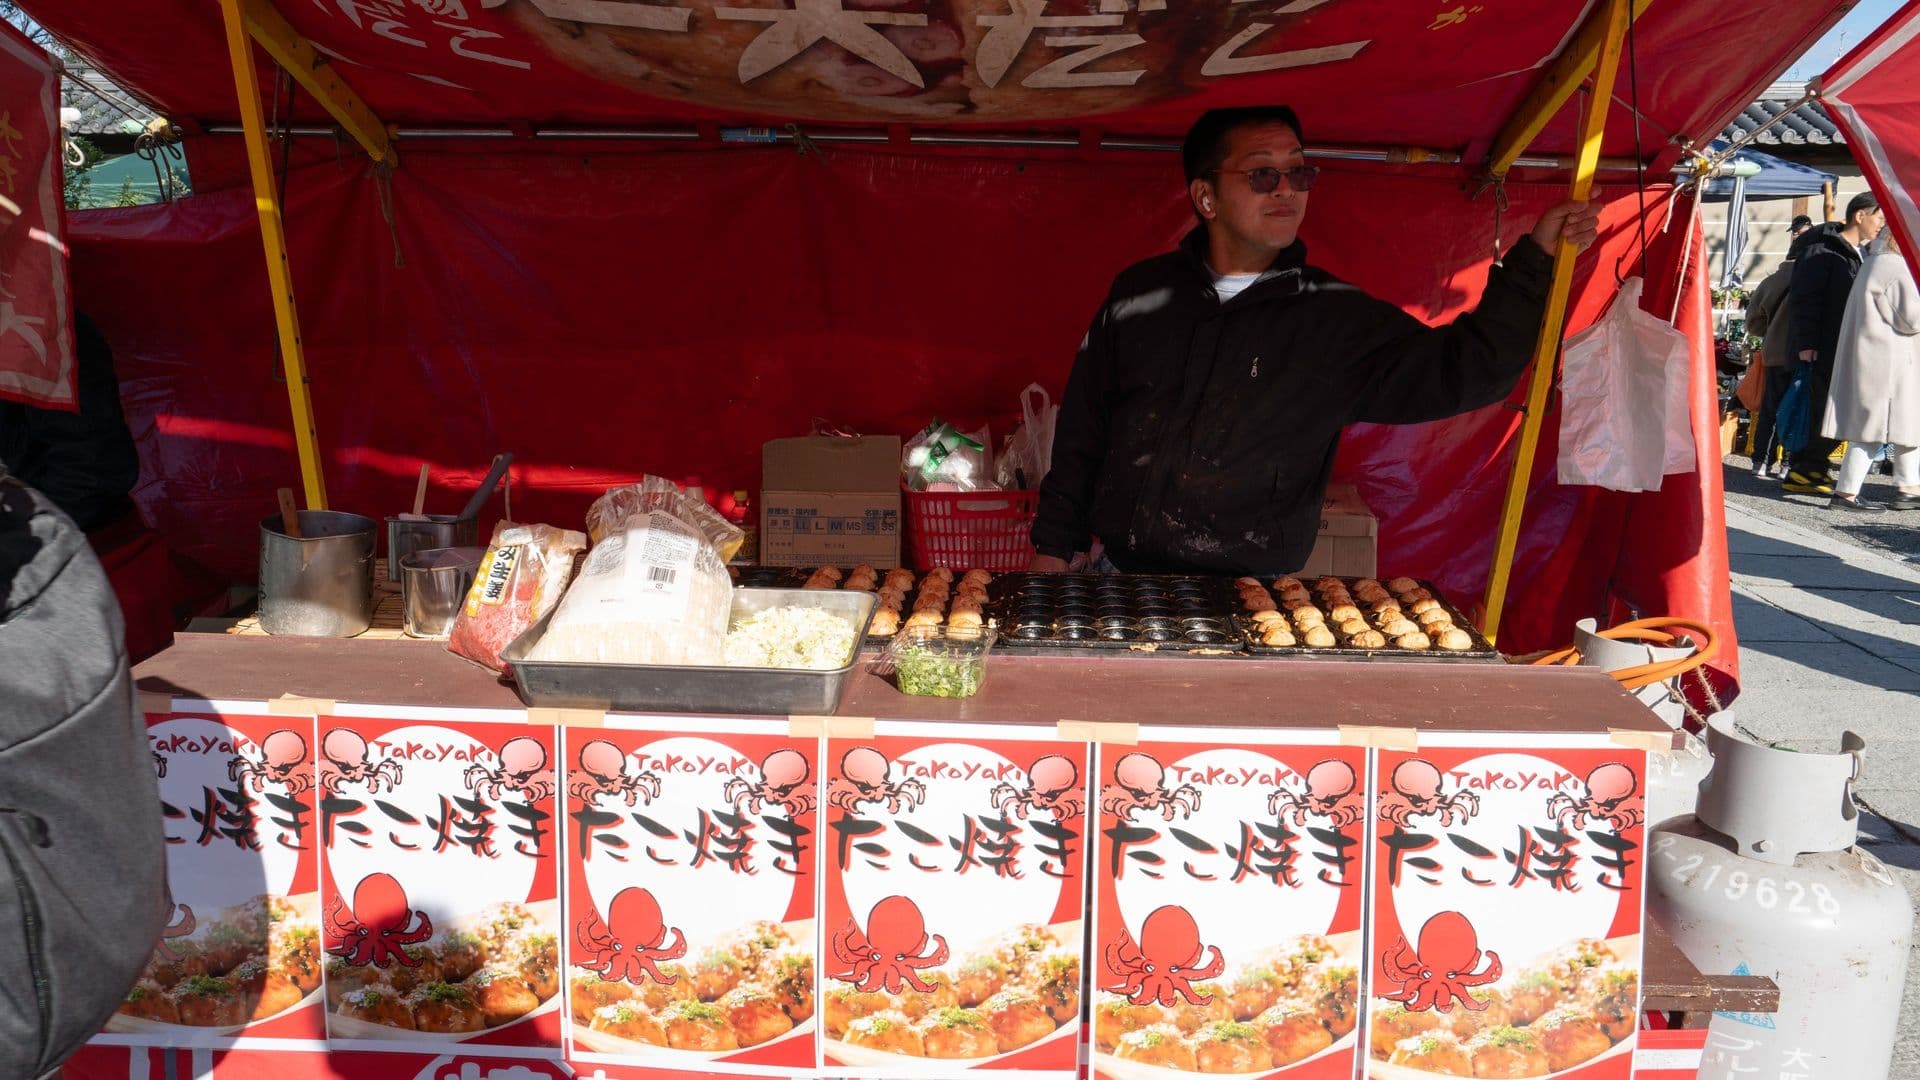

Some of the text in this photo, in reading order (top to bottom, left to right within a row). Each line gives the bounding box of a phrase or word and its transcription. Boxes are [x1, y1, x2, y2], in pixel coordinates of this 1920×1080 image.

[815, 521, 825, 531] L
[831, 521, 843, 531] M
[847, 522, 862, 531] MS
[319, 792, 551, 860] たこ焼き
[569, 803, 812, 876] たこ焼き
[829, 812, 1079, 880] たこ焼き
[1102, 818, 1358, 889] たこ焼き
[1379, 824, 1638, 894] たこ焼き
